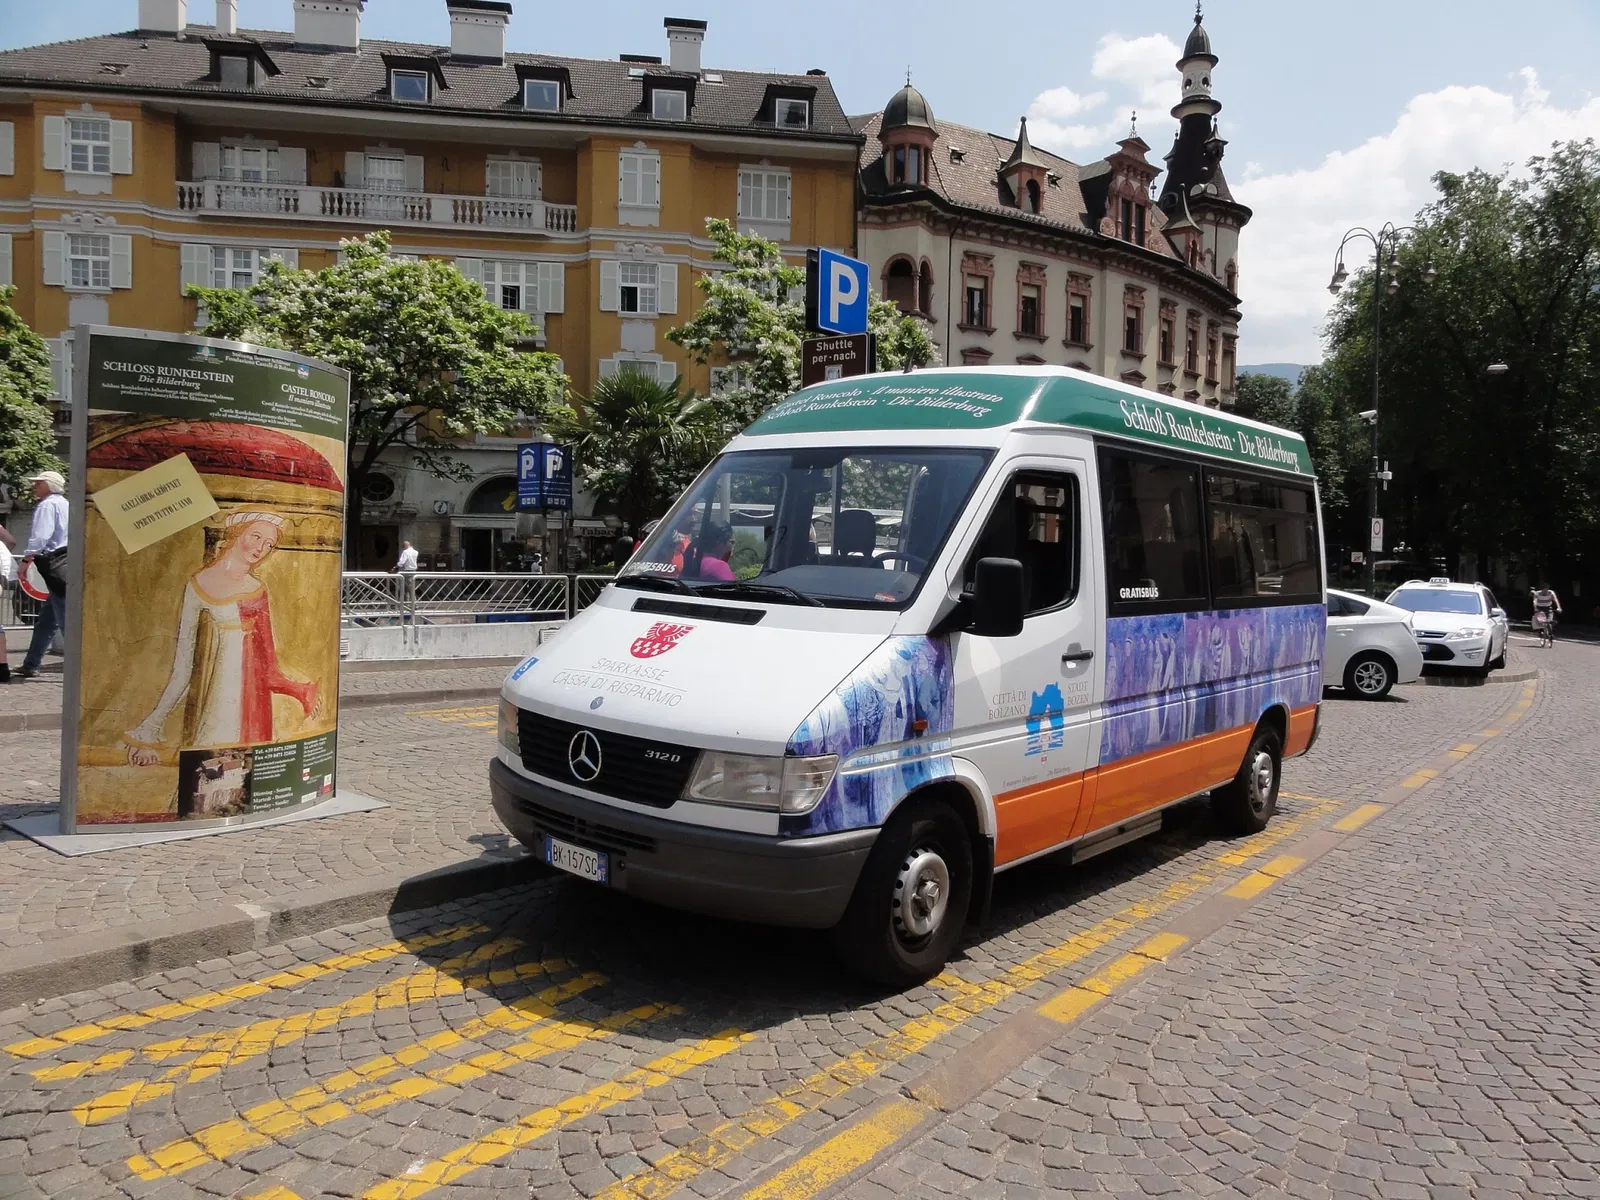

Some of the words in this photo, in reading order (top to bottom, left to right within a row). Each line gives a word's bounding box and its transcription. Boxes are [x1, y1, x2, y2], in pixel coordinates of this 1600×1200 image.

[830, 260, 859, 324] P
[816, 340, 852, 352] Shuttle
[103, 360, 155, 374] SCHLOSS
[157, 366, 234, 383] RUNKELSTEIN
[138, 374, 154, 383] Die
[156, 376, 200, 389] Bilderburg
[281, 384, 309, 397] CASTEL
[310, 386, 336, 404] RONCOLO
[812, 388, 862, 402] Roncolo
[871, 386, 890, 395] Il
[885, 386, 939, 395] maniero
[940, 386, 1003, 402] illustrato
[805, 397, 877, 411] Runkelstein
[886, 396, 915, 405] Die
[914, 396, 992, 417] Bilderburg
[1119, 399, 1168, 436] Schloß
[1165, 412, 1233, 451] Runkelstein
[1237, 431, 1255, 457] Die
[1256, 436, 1300, 473] Bilderburg
[522, 455, 534, 479] P
[546, 454, 562, 478] P
[1120, 587, 1159, 598] GRATISBUS
[592, 658, 669, 680] SPARKASSE
[552, 672, 591, 687] CASSA
[591, 677, 606, 689] DI
[607, 680, 682, 707] RISPARMIO
[1068, 681, 1088, 693] STADT
[992, 690, 1018, 705] CITTÀ
[1018, 690, 1026, 701] DI
[1067, 695, 1089, 706] BOZEN
[988, 704, 1026, 720] BOLZANO
